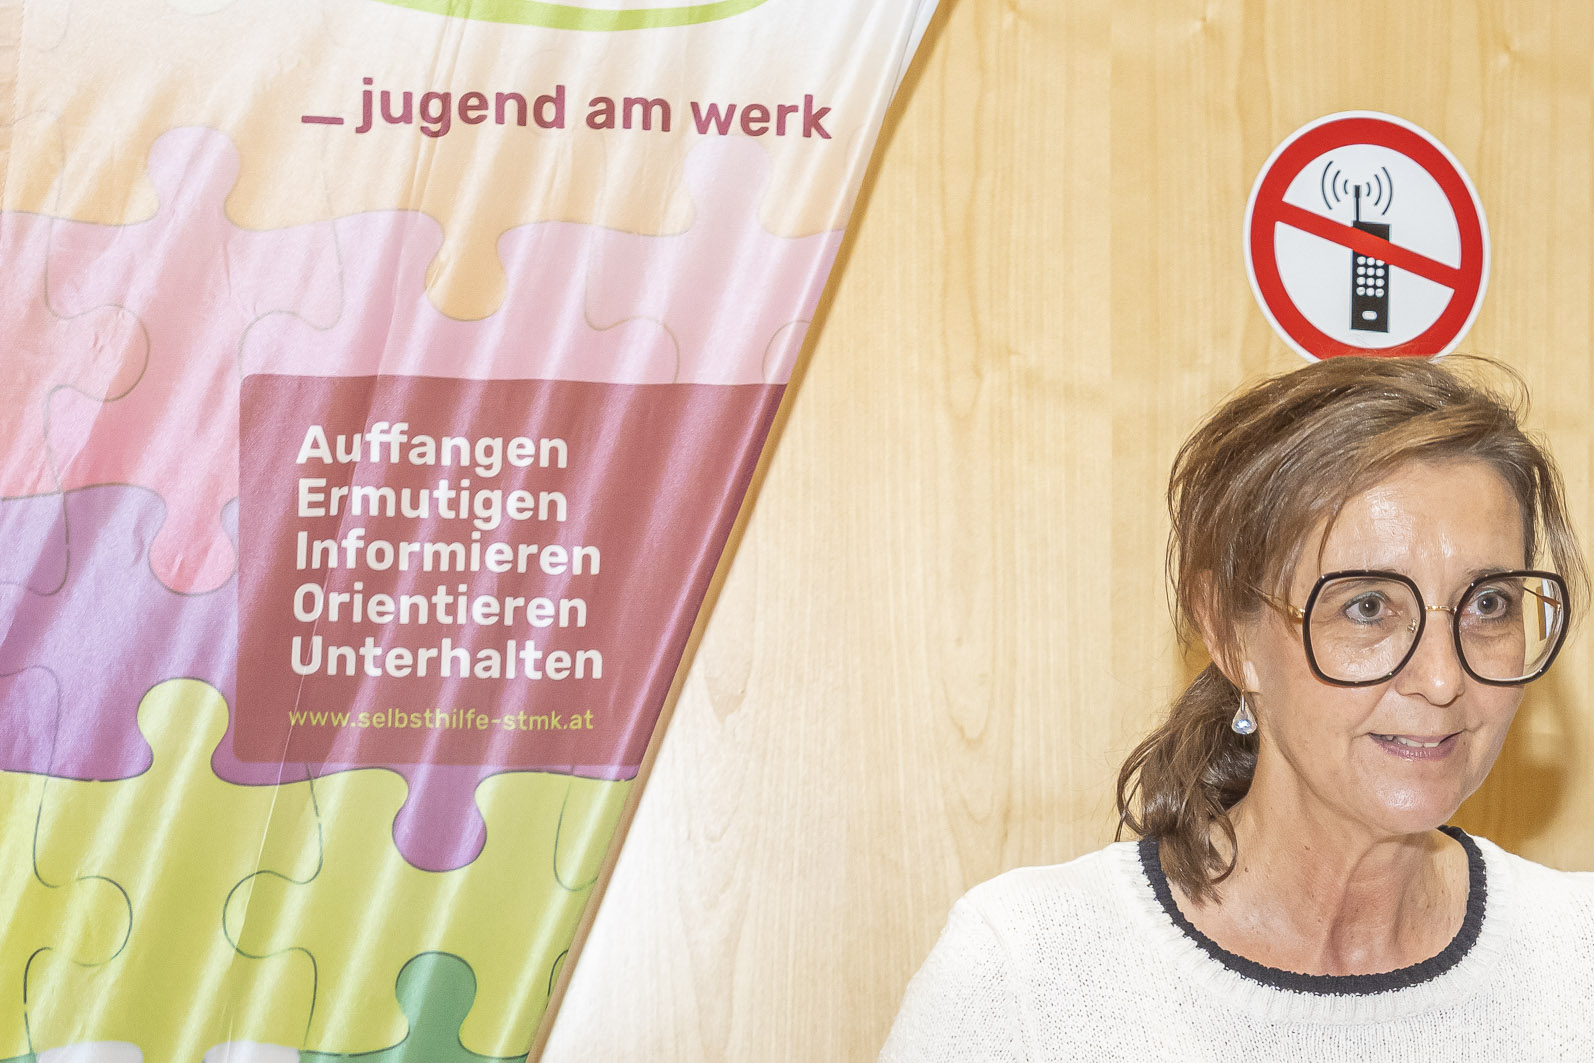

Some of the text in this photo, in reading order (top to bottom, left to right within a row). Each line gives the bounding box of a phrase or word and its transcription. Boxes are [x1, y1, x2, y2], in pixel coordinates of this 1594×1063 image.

[586, 96, 671, 132] am
[690, 94, 832, 139] werk
[296, 422, 568, 478] Auffangen
[298, 477, 567, 530] Ermutigen
[296, 528, 600, 575] Informieren
[293, 581, 587, 628] Orientieren
[291, 635, 603, 681] Unterhalten
[289, 707, 594, 731] www.selbsthilfe-stmk.at
